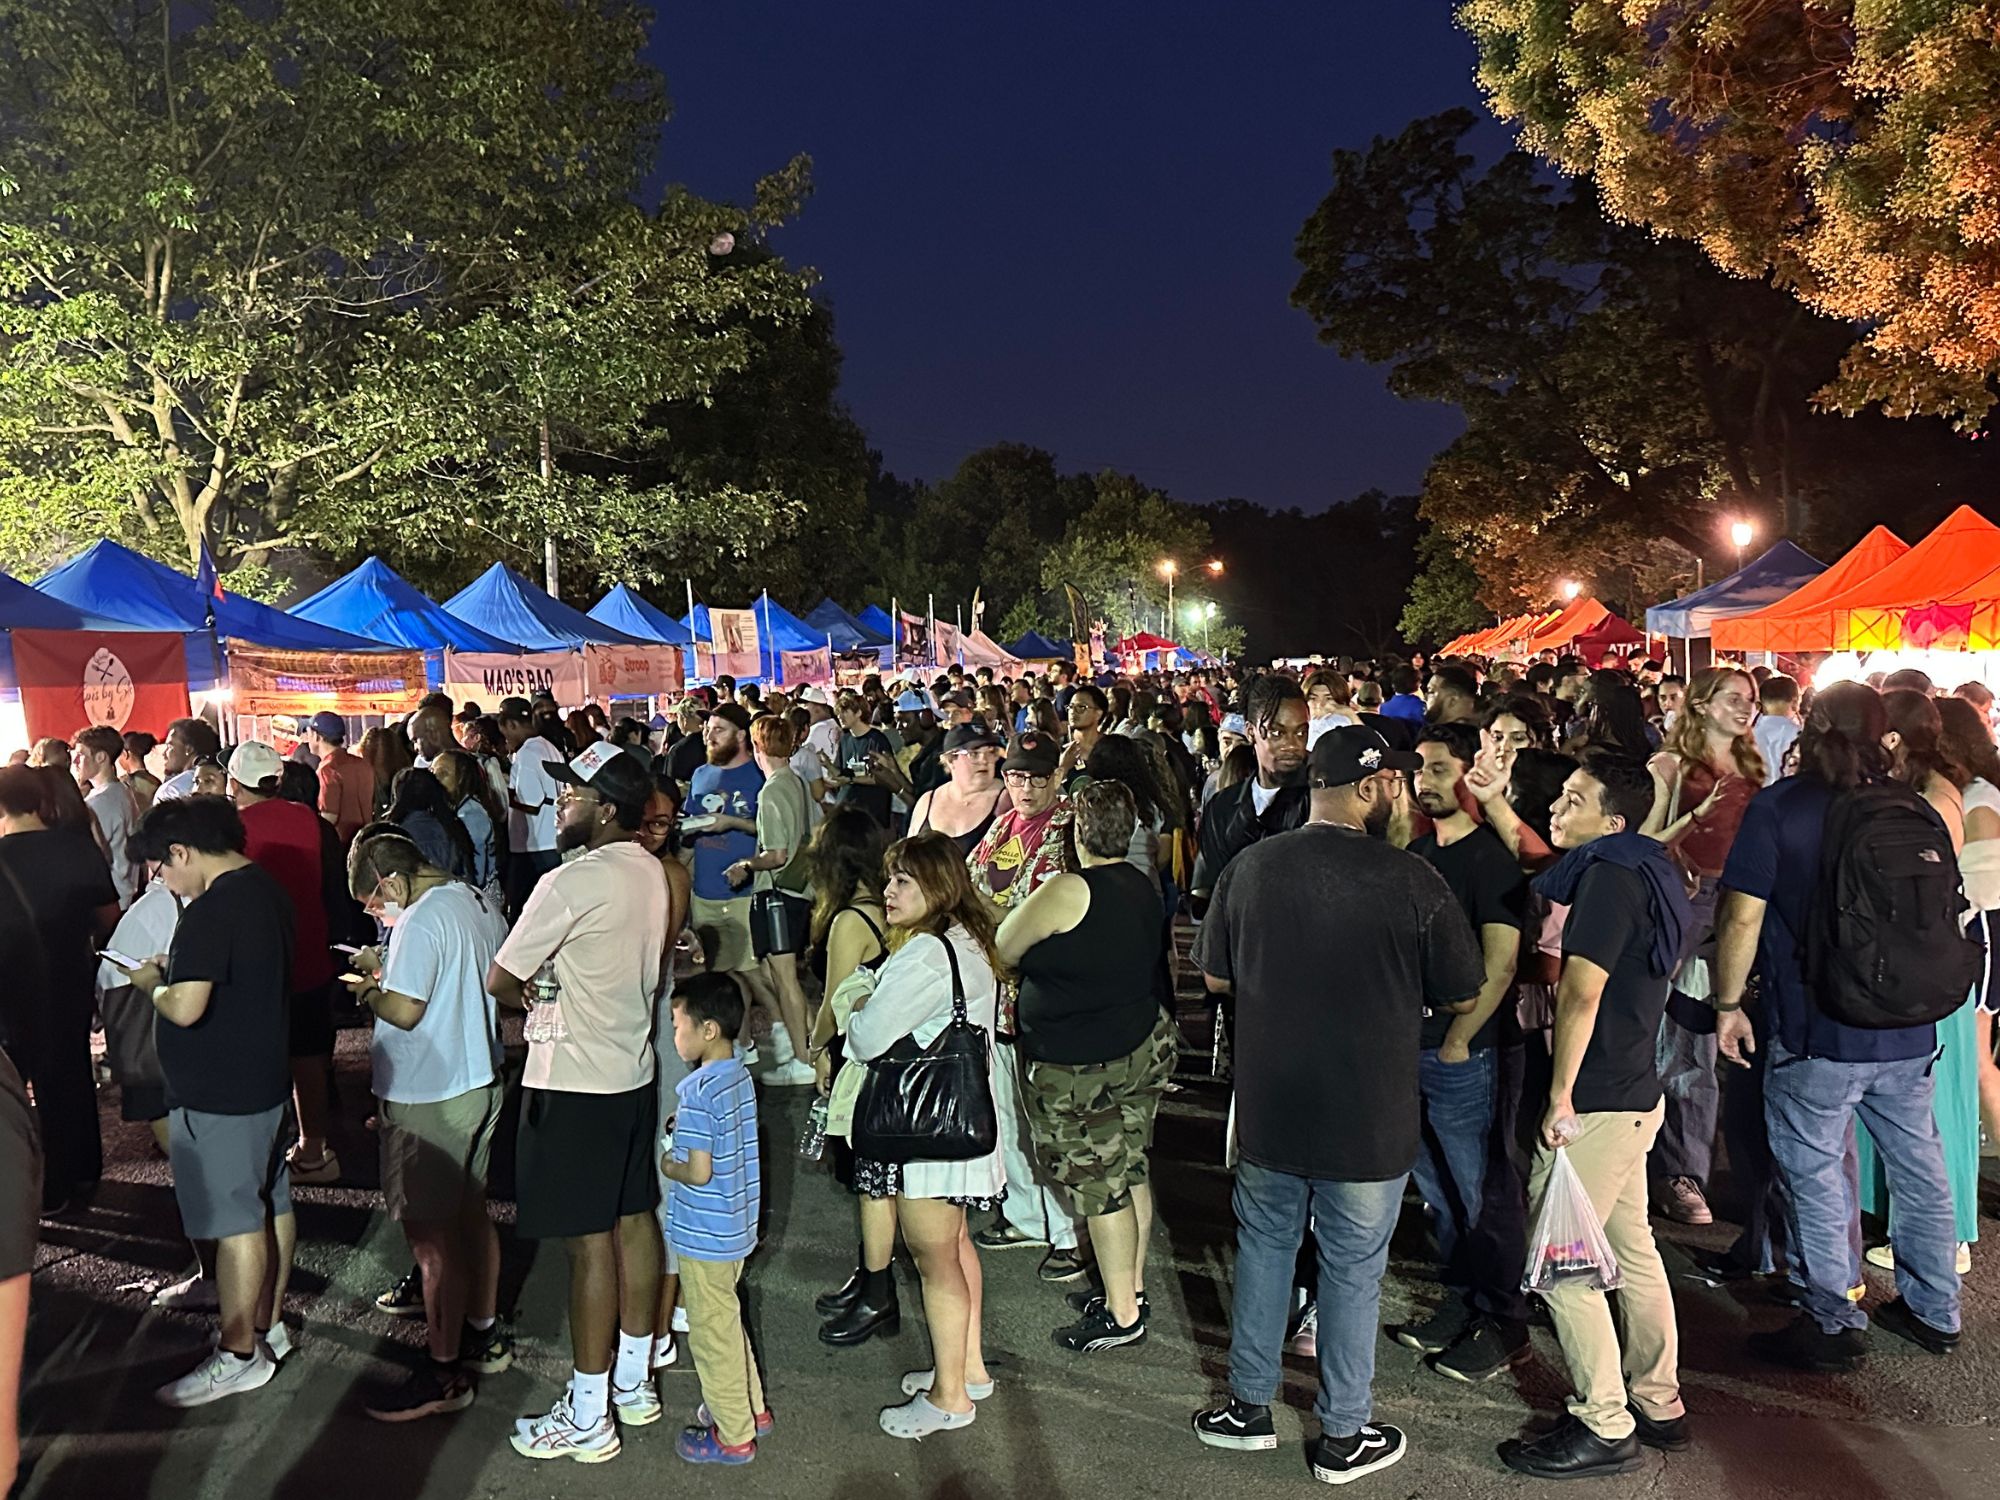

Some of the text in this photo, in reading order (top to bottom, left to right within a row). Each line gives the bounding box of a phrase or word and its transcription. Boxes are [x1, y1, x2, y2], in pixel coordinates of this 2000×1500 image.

[1608, 643, 1641, 657] ATM
[624, 656, 650, 675] Stroop
[483, 668, 554, 696] MAO'S BAO
